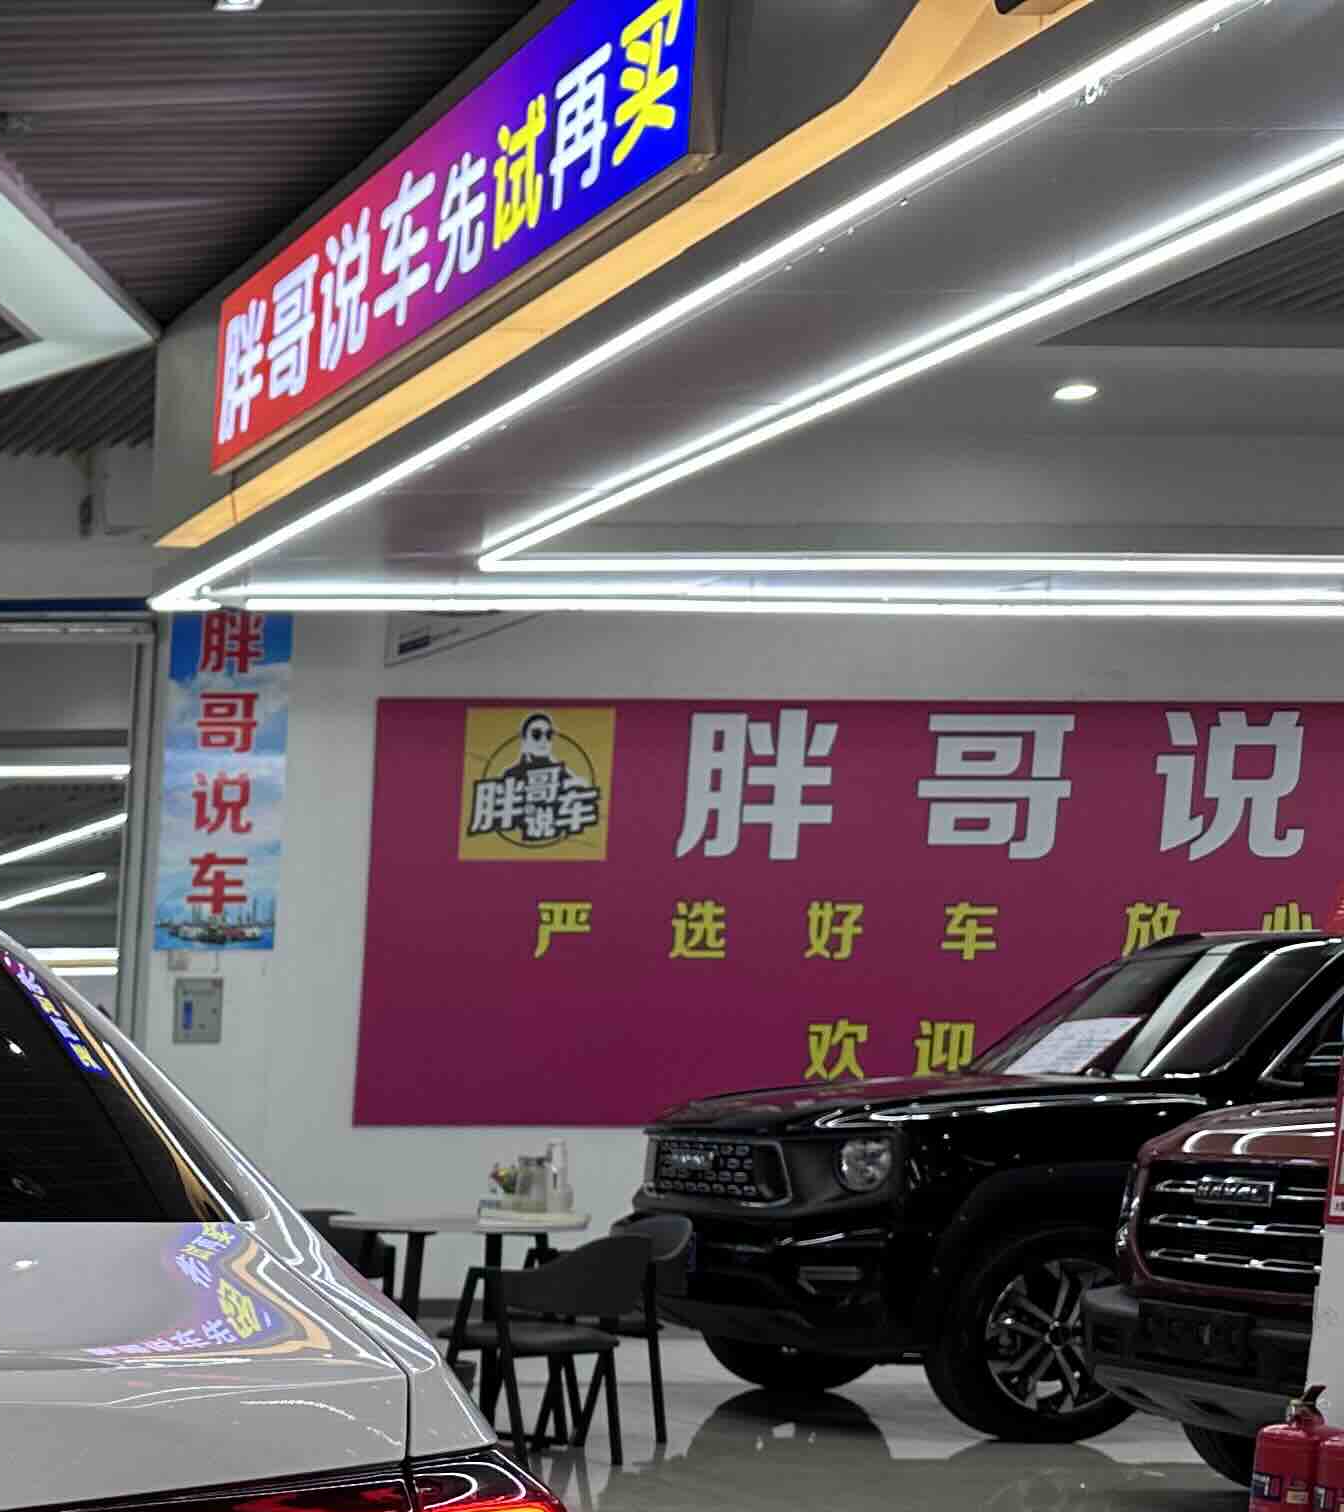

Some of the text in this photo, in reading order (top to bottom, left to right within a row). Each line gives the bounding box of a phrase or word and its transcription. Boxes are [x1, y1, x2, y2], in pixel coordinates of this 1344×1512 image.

[216, 0, 682, 443] 胖哥说车先试再买
[185, 608, 267, 915] 胖哥说车
[676, 707, 1306, 861] 胖哥说
[533, 900, 1000, 961] 严选好车
[804, 1018, 976, 1080] 欢迎
